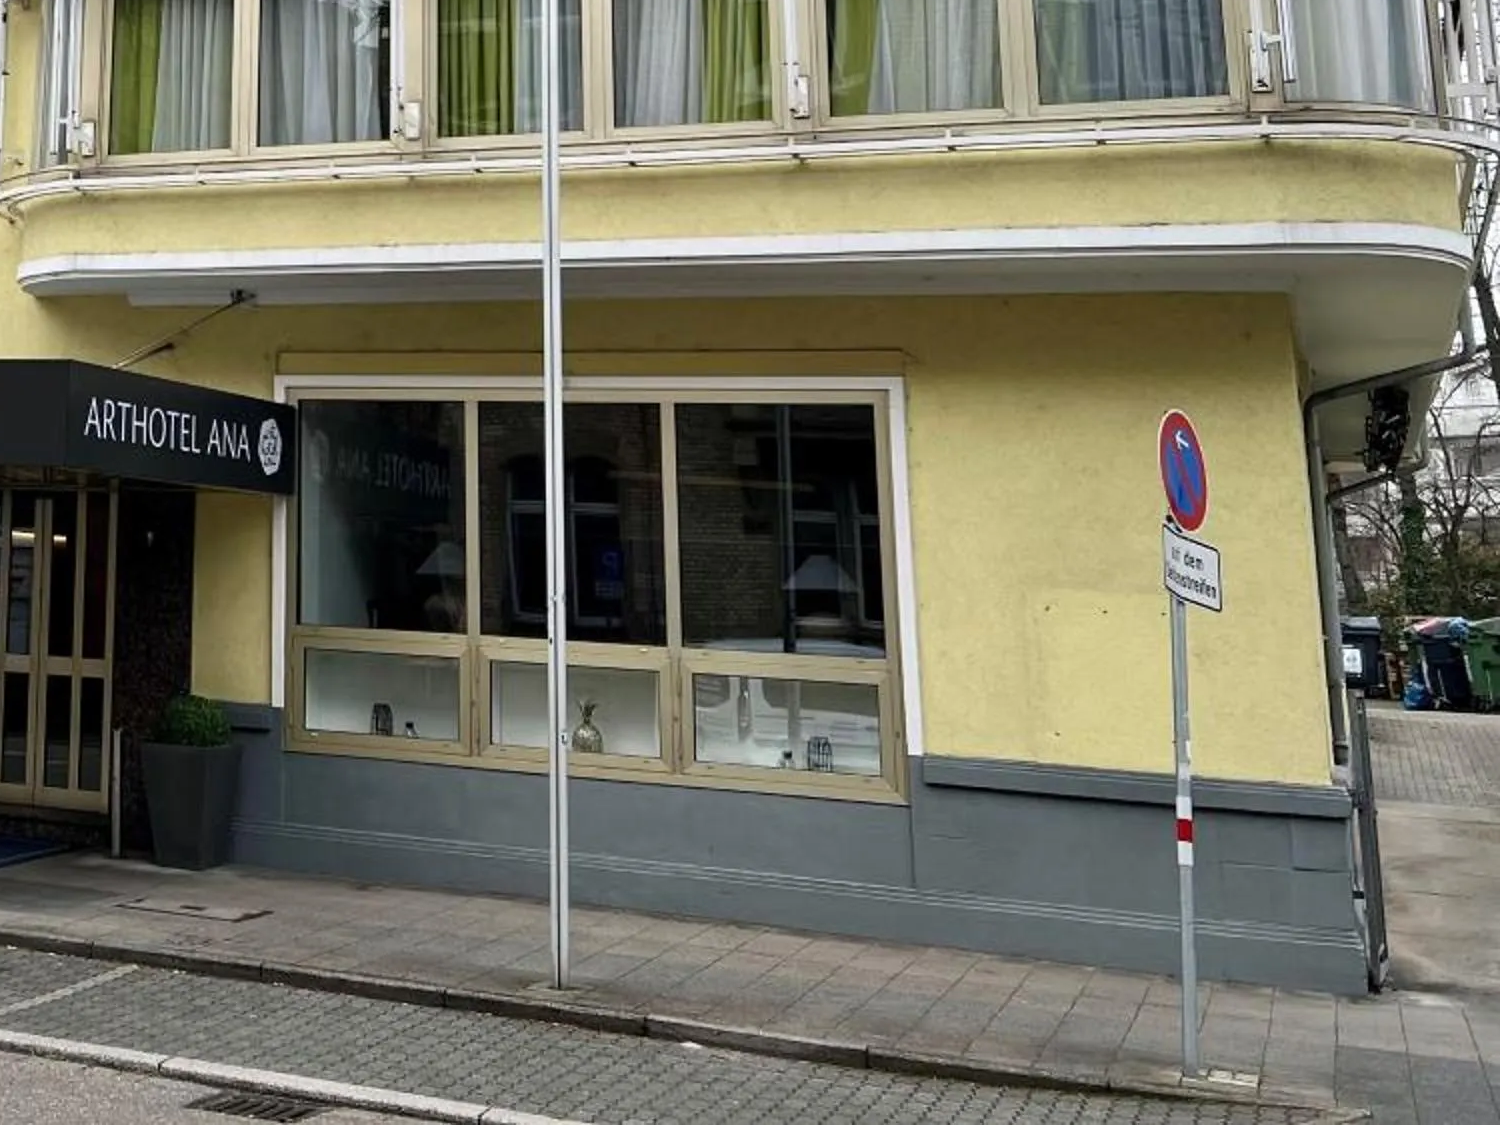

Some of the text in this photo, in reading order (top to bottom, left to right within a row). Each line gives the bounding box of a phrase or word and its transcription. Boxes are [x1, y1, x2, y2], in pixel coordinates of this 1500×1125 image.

[84, 396, 201, 454] ARTHOTEL
[207, 418, 251, 463] ANA
[1184, 552, 1204, 570] dem
